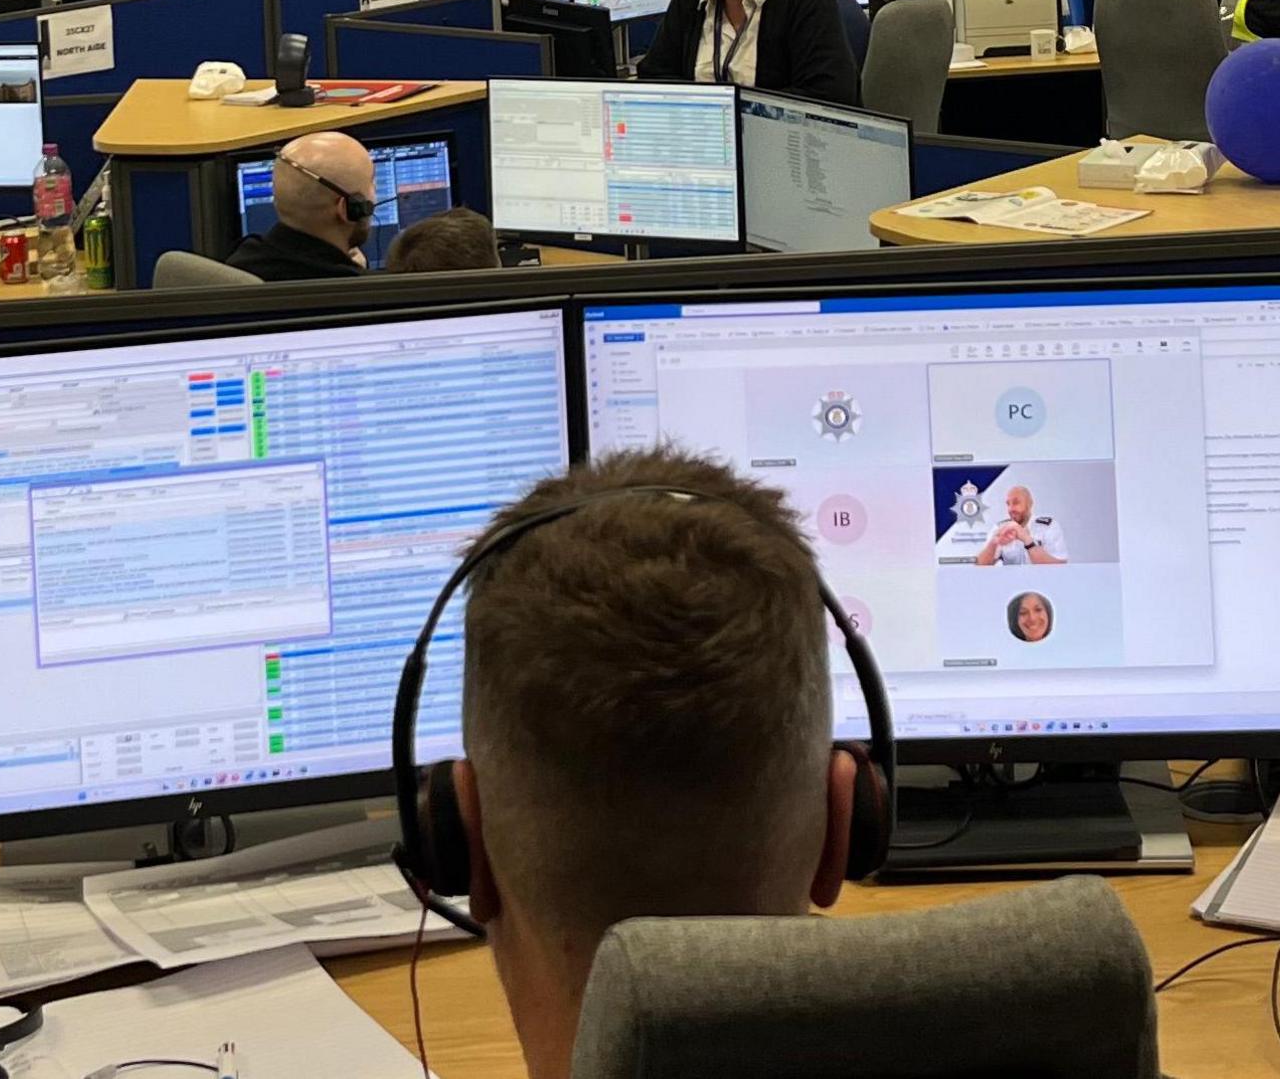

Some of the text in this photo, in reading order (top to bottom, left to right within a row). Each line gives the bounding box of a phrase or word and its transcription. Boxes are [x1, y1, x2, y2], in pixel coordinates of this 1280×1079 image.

[56, 46, 86, 56] NORTH
[1008, 404, 1033, 420] PC
[833, 511, 851, 527] IB
